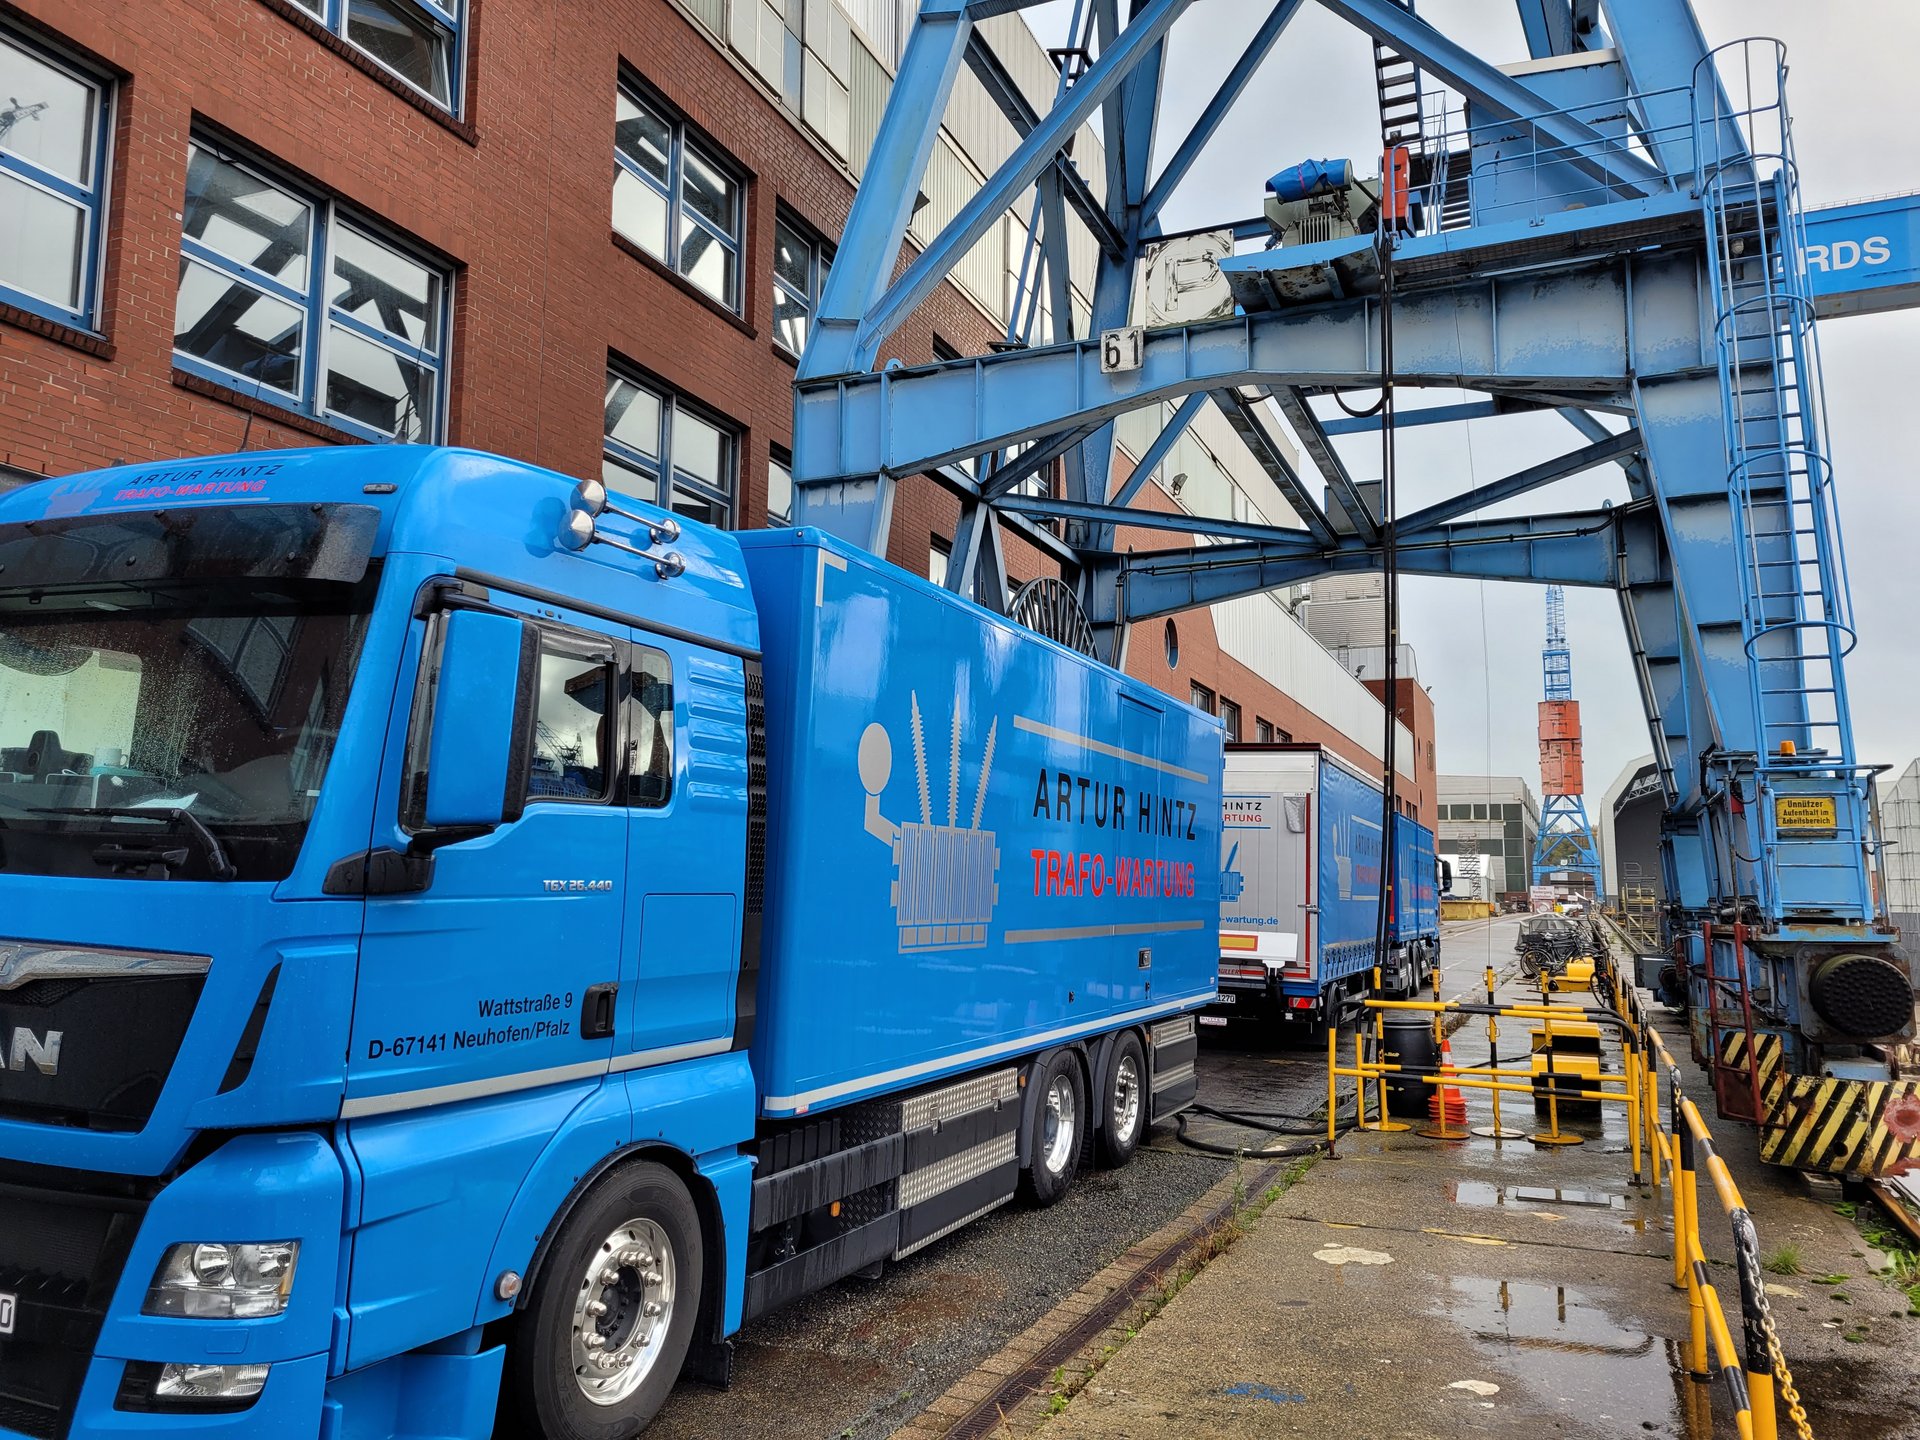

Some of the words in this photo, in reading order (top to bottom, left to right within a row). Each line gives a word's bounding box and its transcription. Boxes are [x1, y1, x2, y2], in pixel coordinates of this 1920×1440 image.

[1105, 330, 1139, 369] 61
[126, 470, 202, 486] ARTUR
[208, 464, 284, 479] HINTZ
[113, 479, 267, 501] TRAFO-WARTUNG
[1032, 768, 1126, 831] ARTUR
[1138, 791, 1197, 841] HINTZ
[1787, 800, 1823, 808] Unnützer
[1222, 813, 1262, 822] RTUNG
[1031, 849, 1195, 898] TRAFO-WARTUNG
[543, 880, 566, 891] TGX
[568, 880, 613, 892] 26.440
[1219, 916, 1278, 926] -wartung.de
[478, 994, 560, 1018] Wattstraße
[564, 992, 573, 1009] 9
[367, 1033, 447, 1060] D-67141
[452, 1019, 571, 1050] Neuhofen/Pfalz
